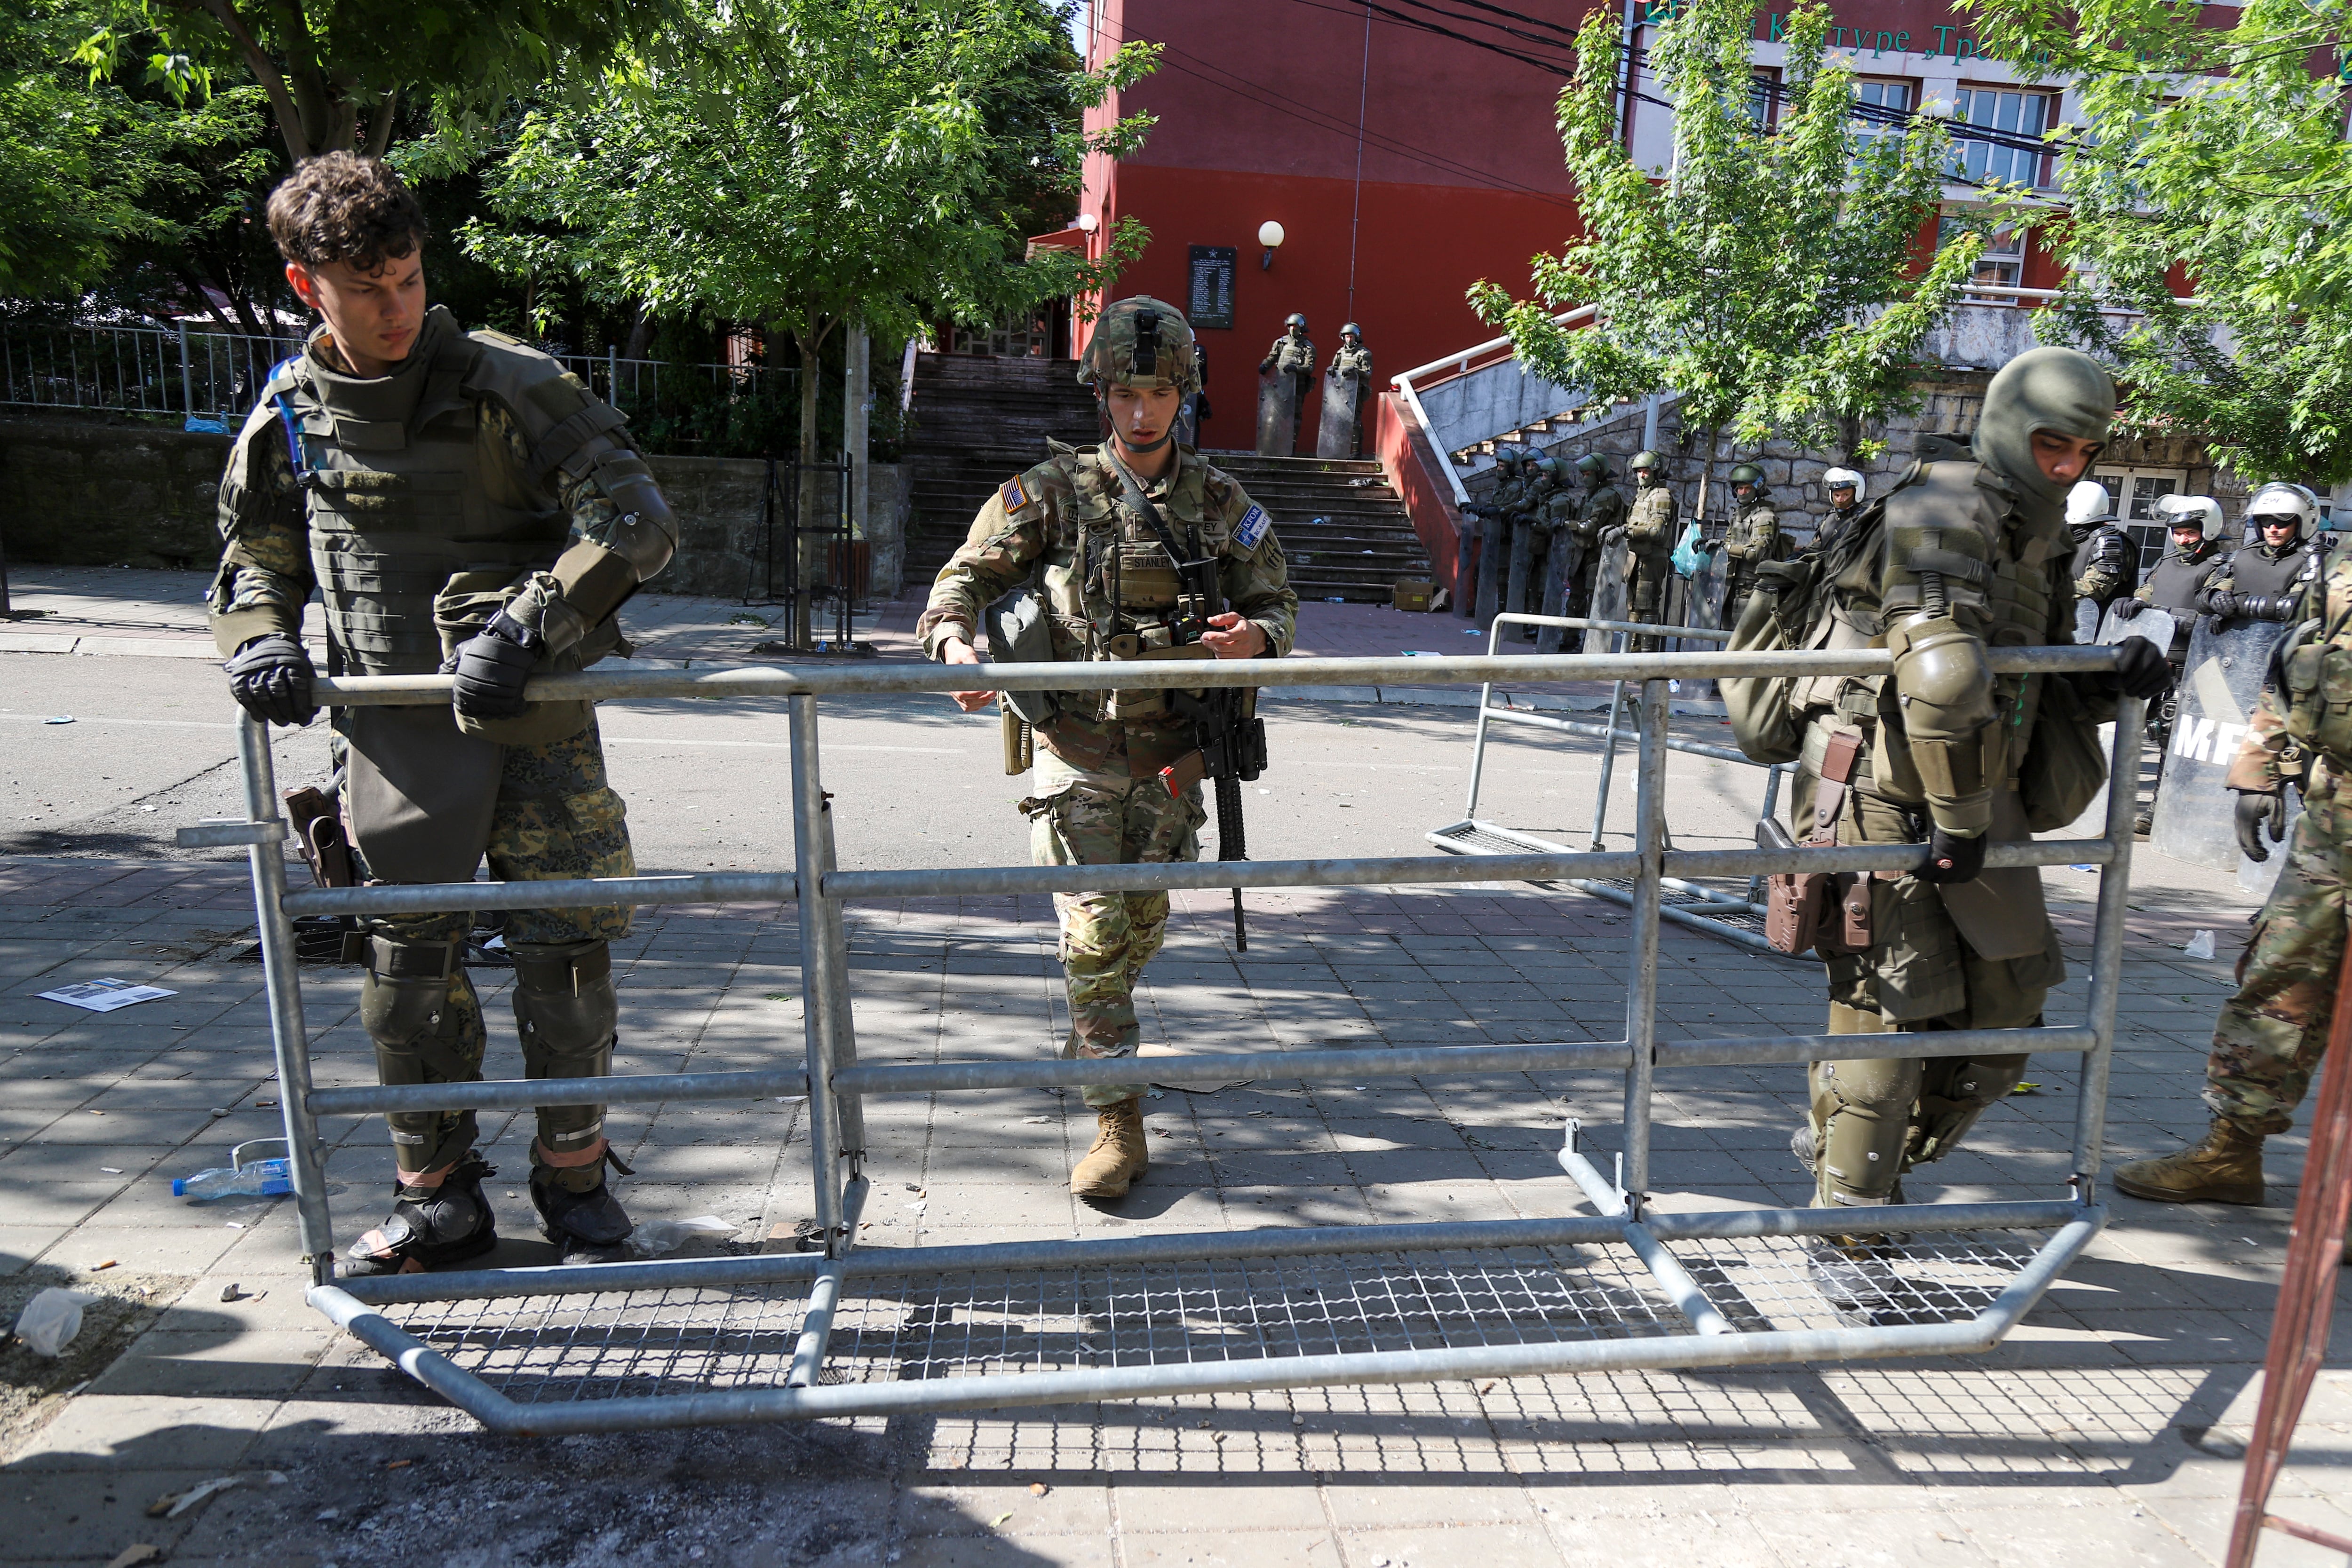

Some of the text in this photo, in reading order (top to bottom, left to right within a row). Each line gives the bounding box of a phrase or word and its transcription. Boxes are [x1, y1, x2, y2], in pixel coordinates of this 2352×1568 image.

[1767, 13, 1910, 59] Ктуре
[1243, 508, 1261, 529] KFOR
[1254, 515, 1269, 537] RC-EAST
[1234, 527, 1243, 538] NATO
[1249, 538, 1258, 549] OTAN
[1134, 558, 1170, 568] STANLEY
